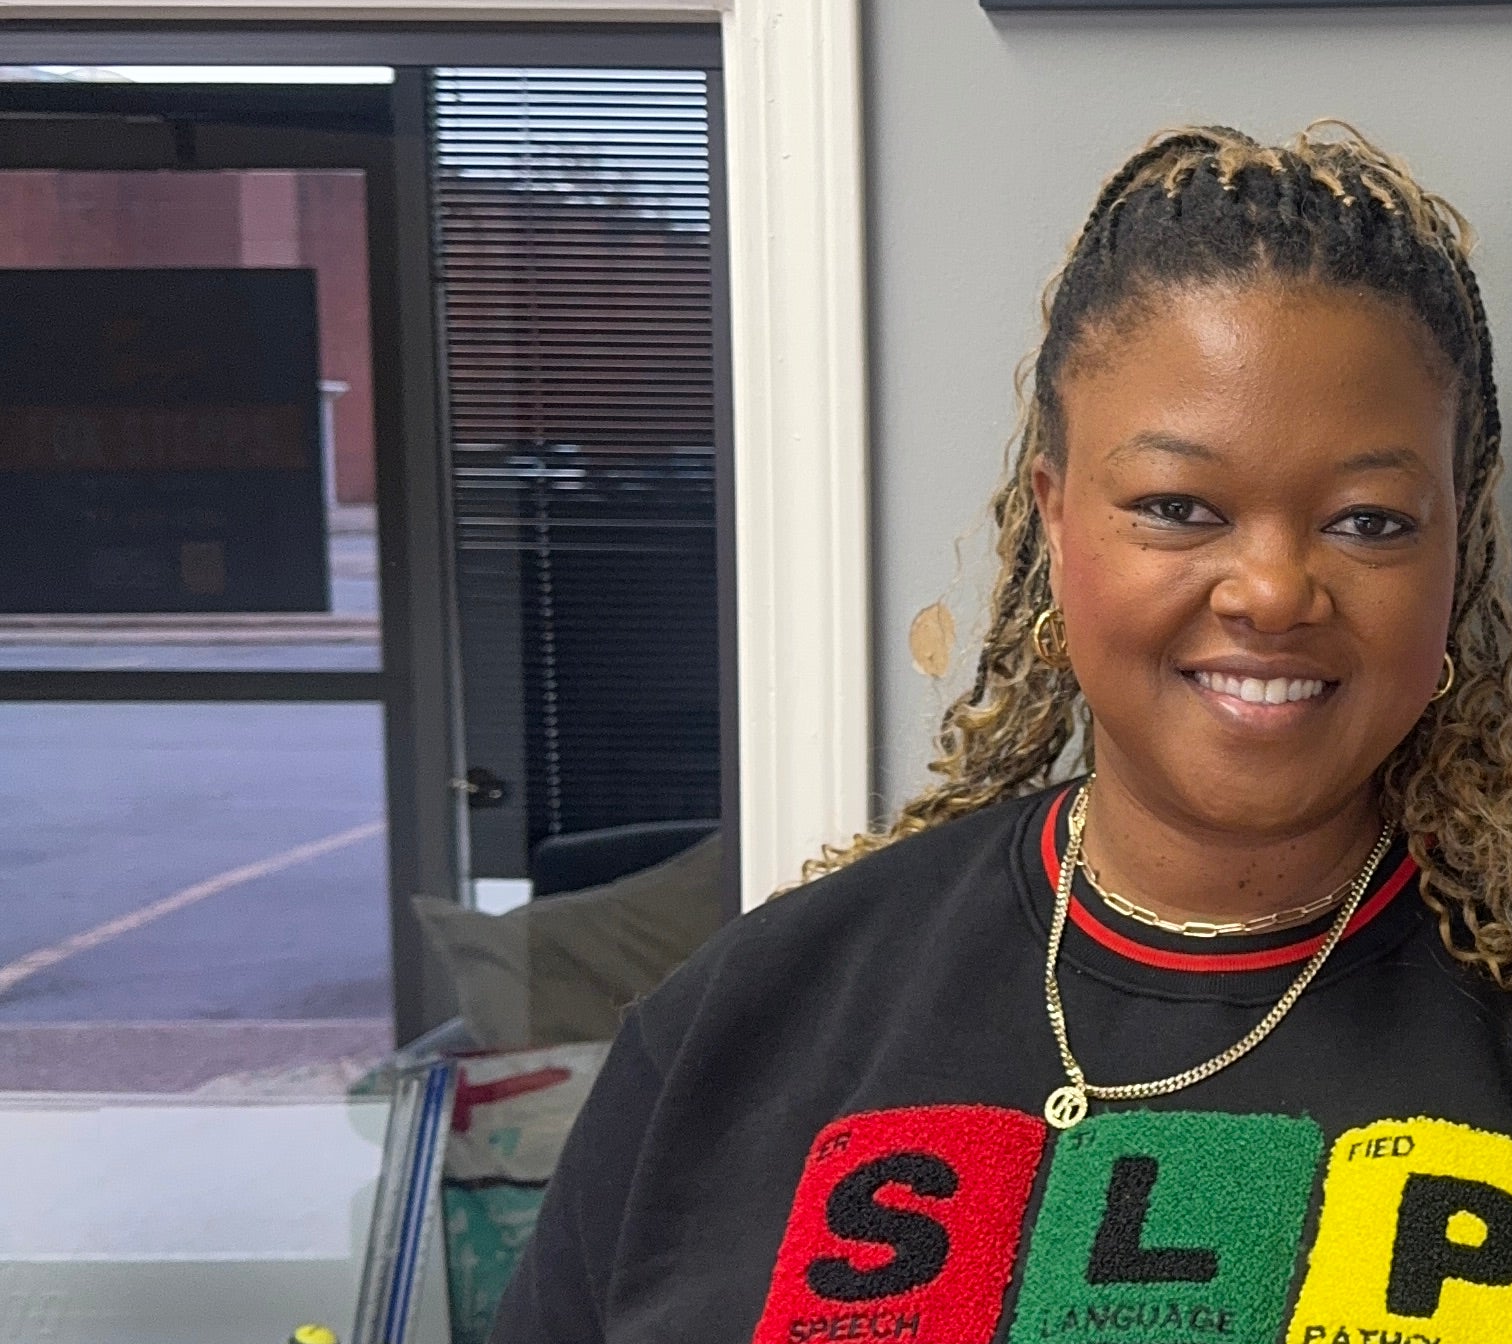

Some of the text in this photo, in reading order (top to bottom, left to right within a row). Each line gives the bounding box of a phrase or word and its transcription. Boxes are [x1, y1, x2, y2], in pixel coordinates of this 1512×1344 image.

[1349, 1135, 1415, 1161] FIED
[804, 1152, 960, 1302] S
[1085, 1156, 1219, 1286] L
